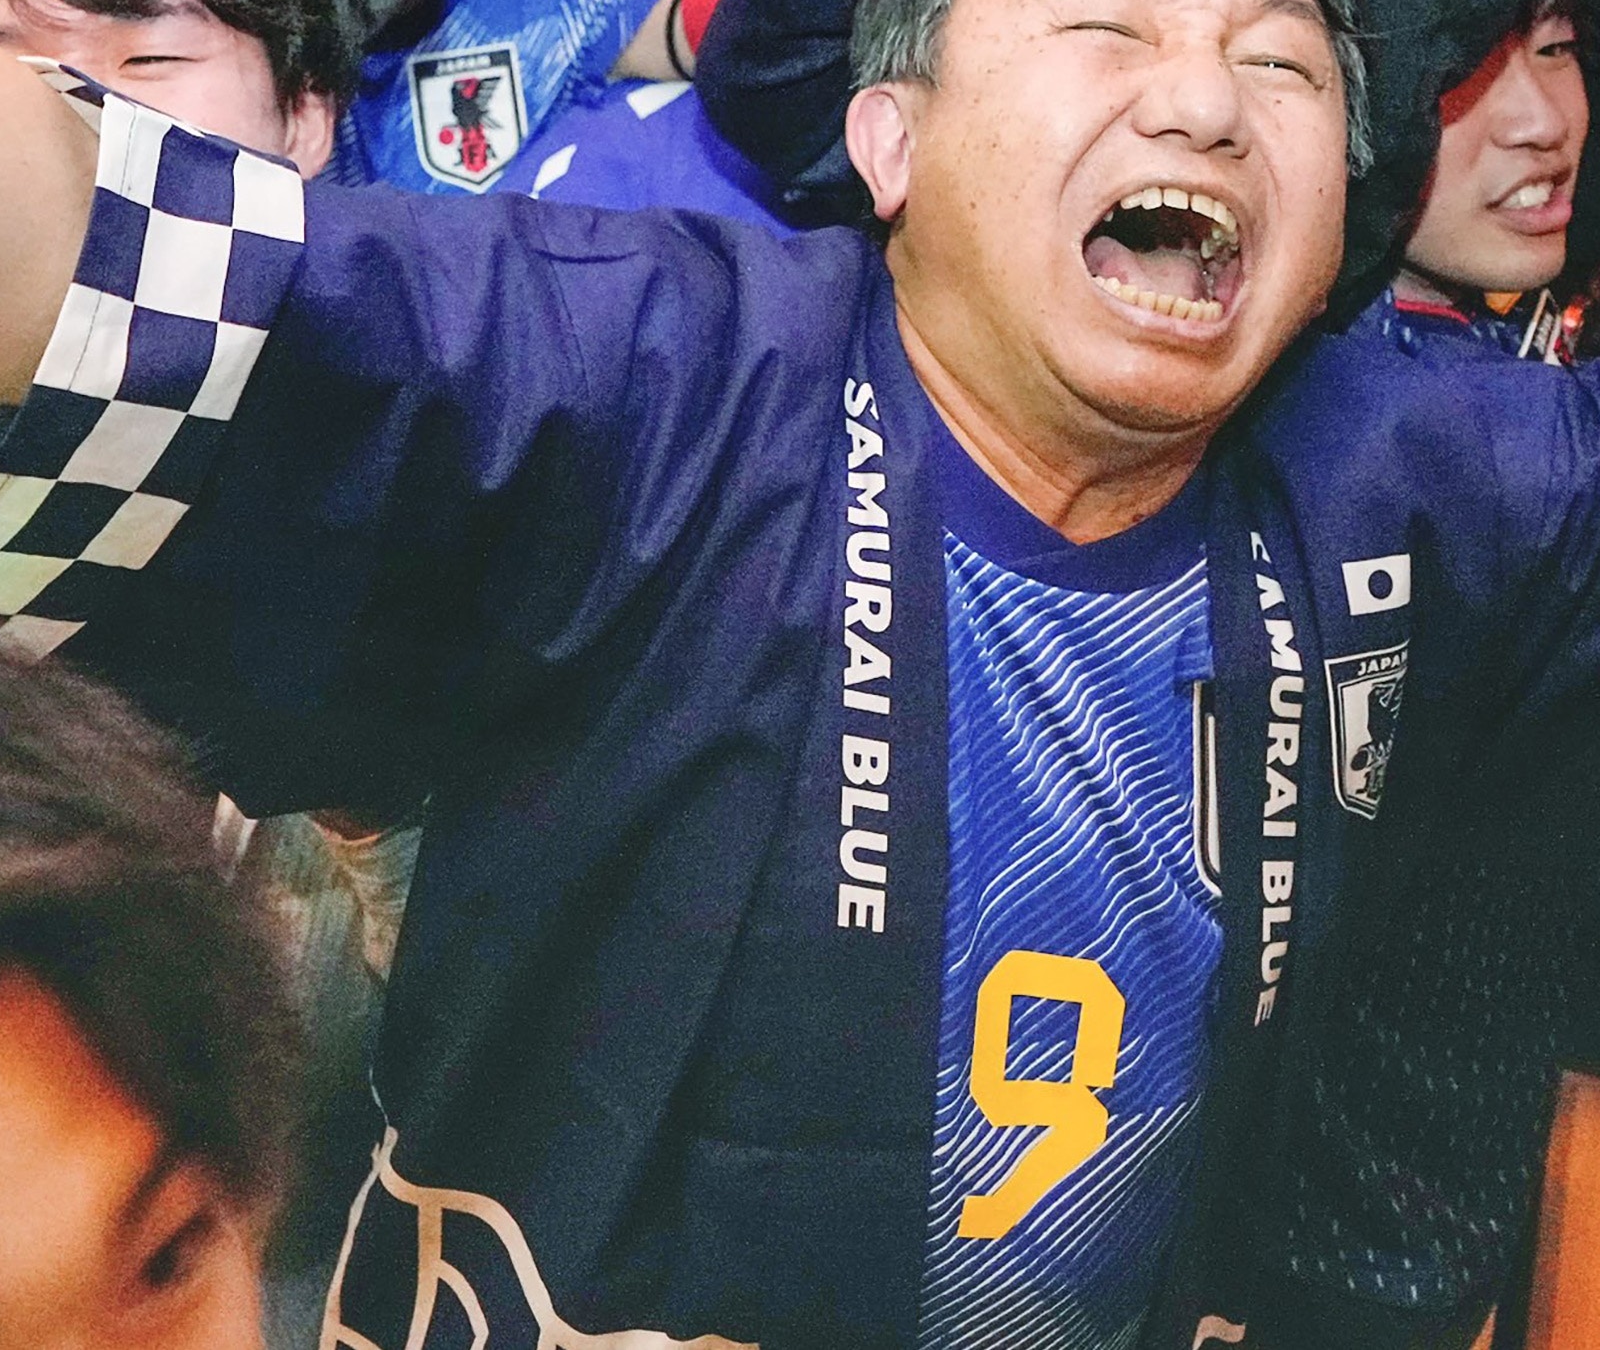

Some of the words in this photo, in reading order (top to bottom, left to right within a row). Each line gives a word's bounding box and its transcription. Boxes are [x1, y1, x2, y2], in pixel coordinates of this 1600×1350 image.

[842, 377, 895, 716] SAMURAI
[837, 733, 890, 934] BLUE
[1253, 860, 1295, 1028] BLUE
[956, 949, 1126, 1240] 9
